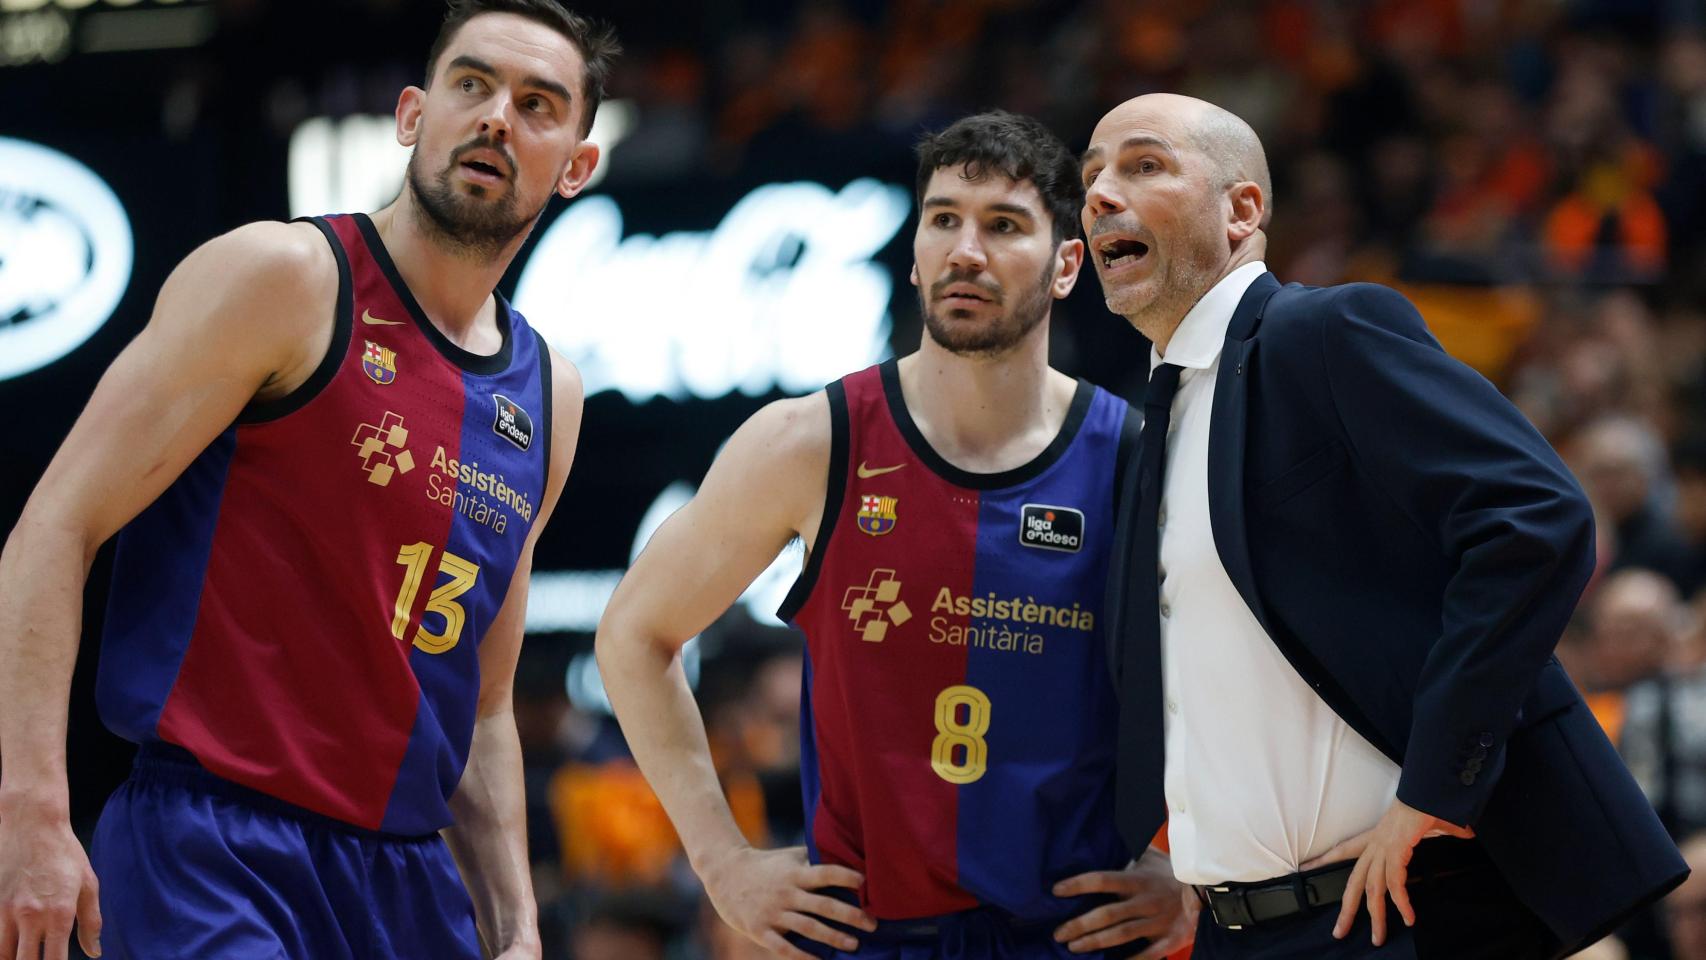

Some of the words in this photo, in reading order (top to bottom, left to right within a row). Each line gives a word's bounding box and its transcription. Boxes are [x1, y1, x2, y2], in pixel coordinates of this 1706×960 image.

[499, 419, 529, 445] endesa
[500, 405, 515, 424] liga
[426, 474, 508, 535] Sanitària
[430, 446, 532, 523] Assistència
[1026, 530, 1078, 546] endesa
[1027, 515, 1052, 531] liga
[391, 541, 480, 655] 13
[931, 587, 1094, 631] Assistència
[928, 616, 1044, 654] Sanitària
[931, 684, 992, 784] 8
